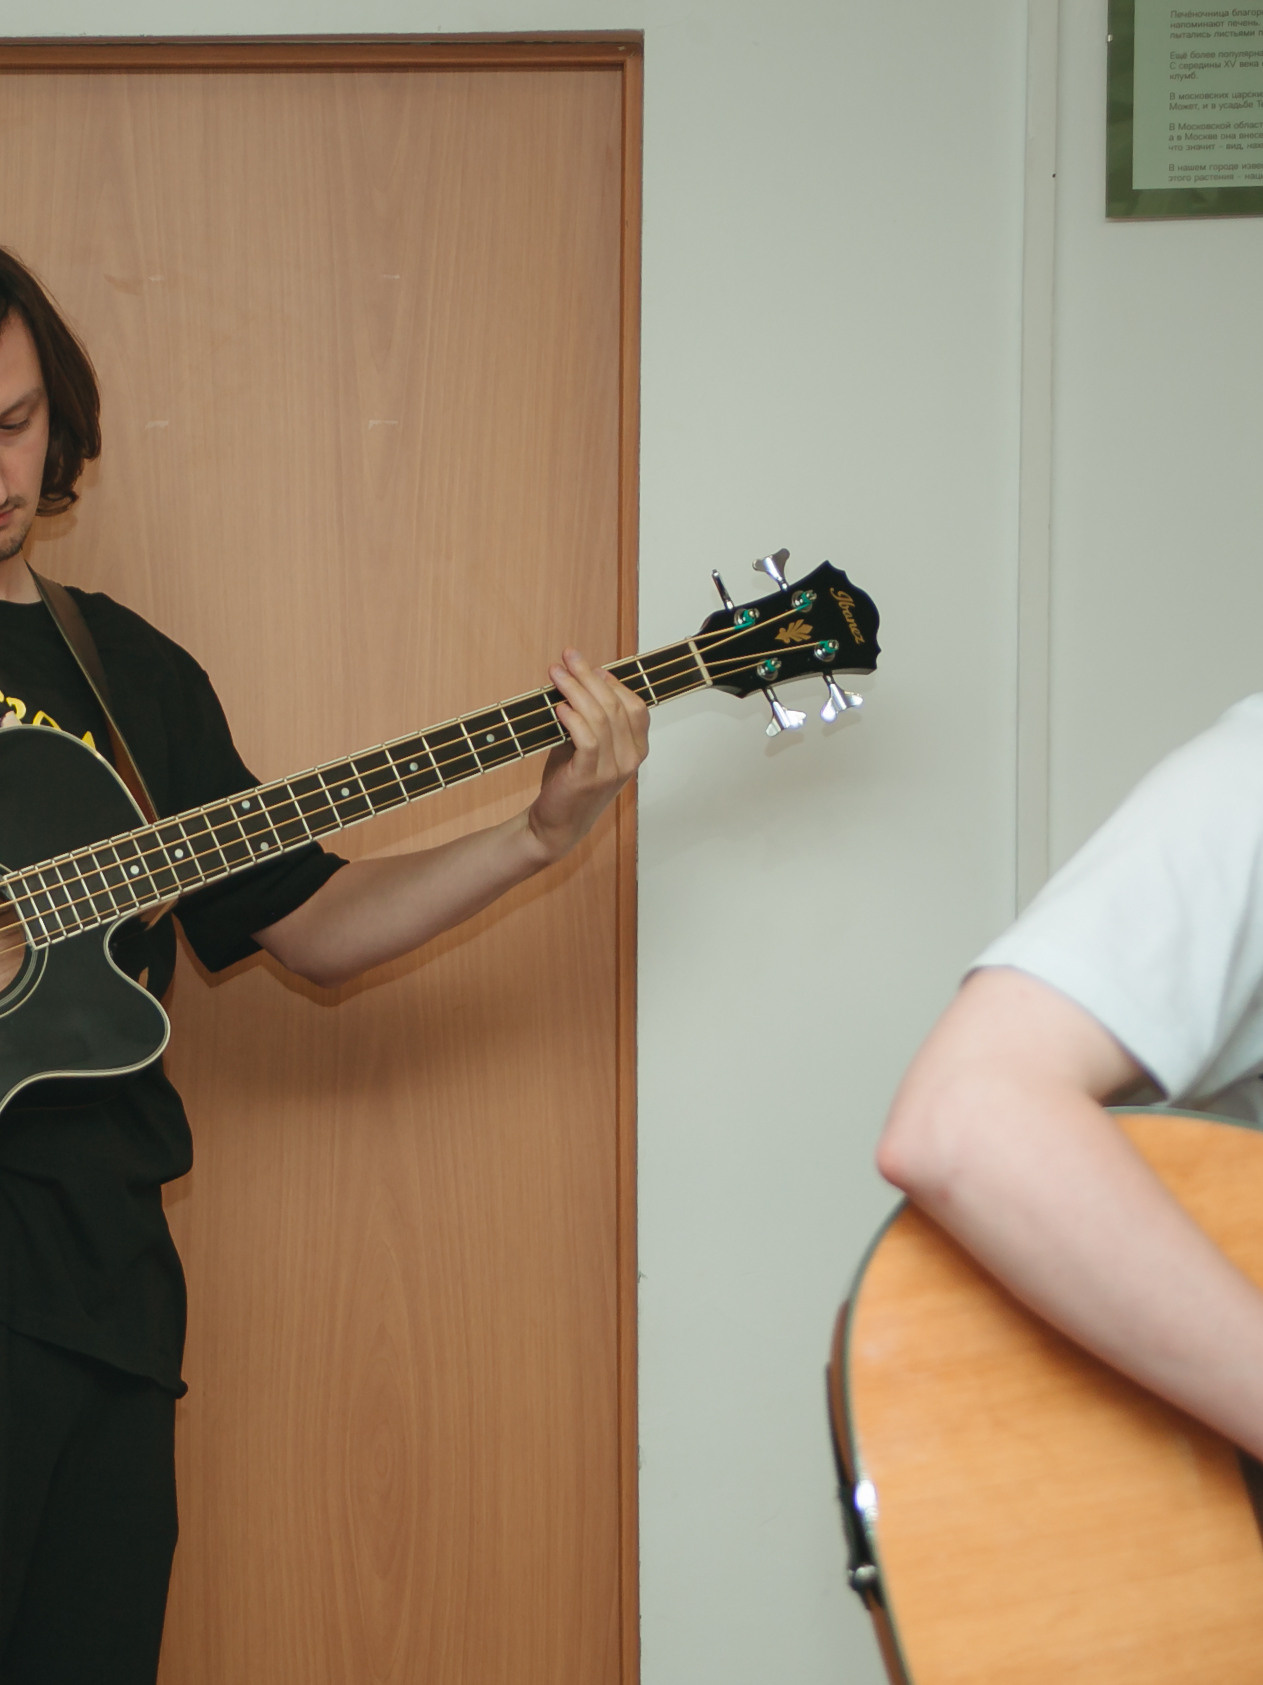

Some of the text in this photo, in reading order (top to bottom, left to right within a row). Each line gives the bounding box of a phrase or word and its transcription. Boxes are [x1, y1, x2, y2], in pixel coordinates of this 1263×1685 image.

[1170, 21, 1224, 29] напоминают
[1213, 30, 1255, 38] листьями
[1190, 50, 1215, 59] более
[1169, 61, 1176, 70] С
[1178, 61, 1221, 71] середины
[1224, 60, 1237, 68] XV
[1169, 92, 1176, 100] В
[1169, 103, 1200, 111] Может,
[1218, 101, 1253, 111] усадьбе
[1168, 123, 1175, 131] В
[1178, 122, 1231, 130] Московской
[1185, 133, 1217, 141] Москве
[1185, 143, 1215, 151] значит
[1168, 163, 1175, 171] В
[1209, 163, 1238, 172] городе
[1194, 174, 1234, 183] растения
[830, 587, 866, 645] Ibanez
